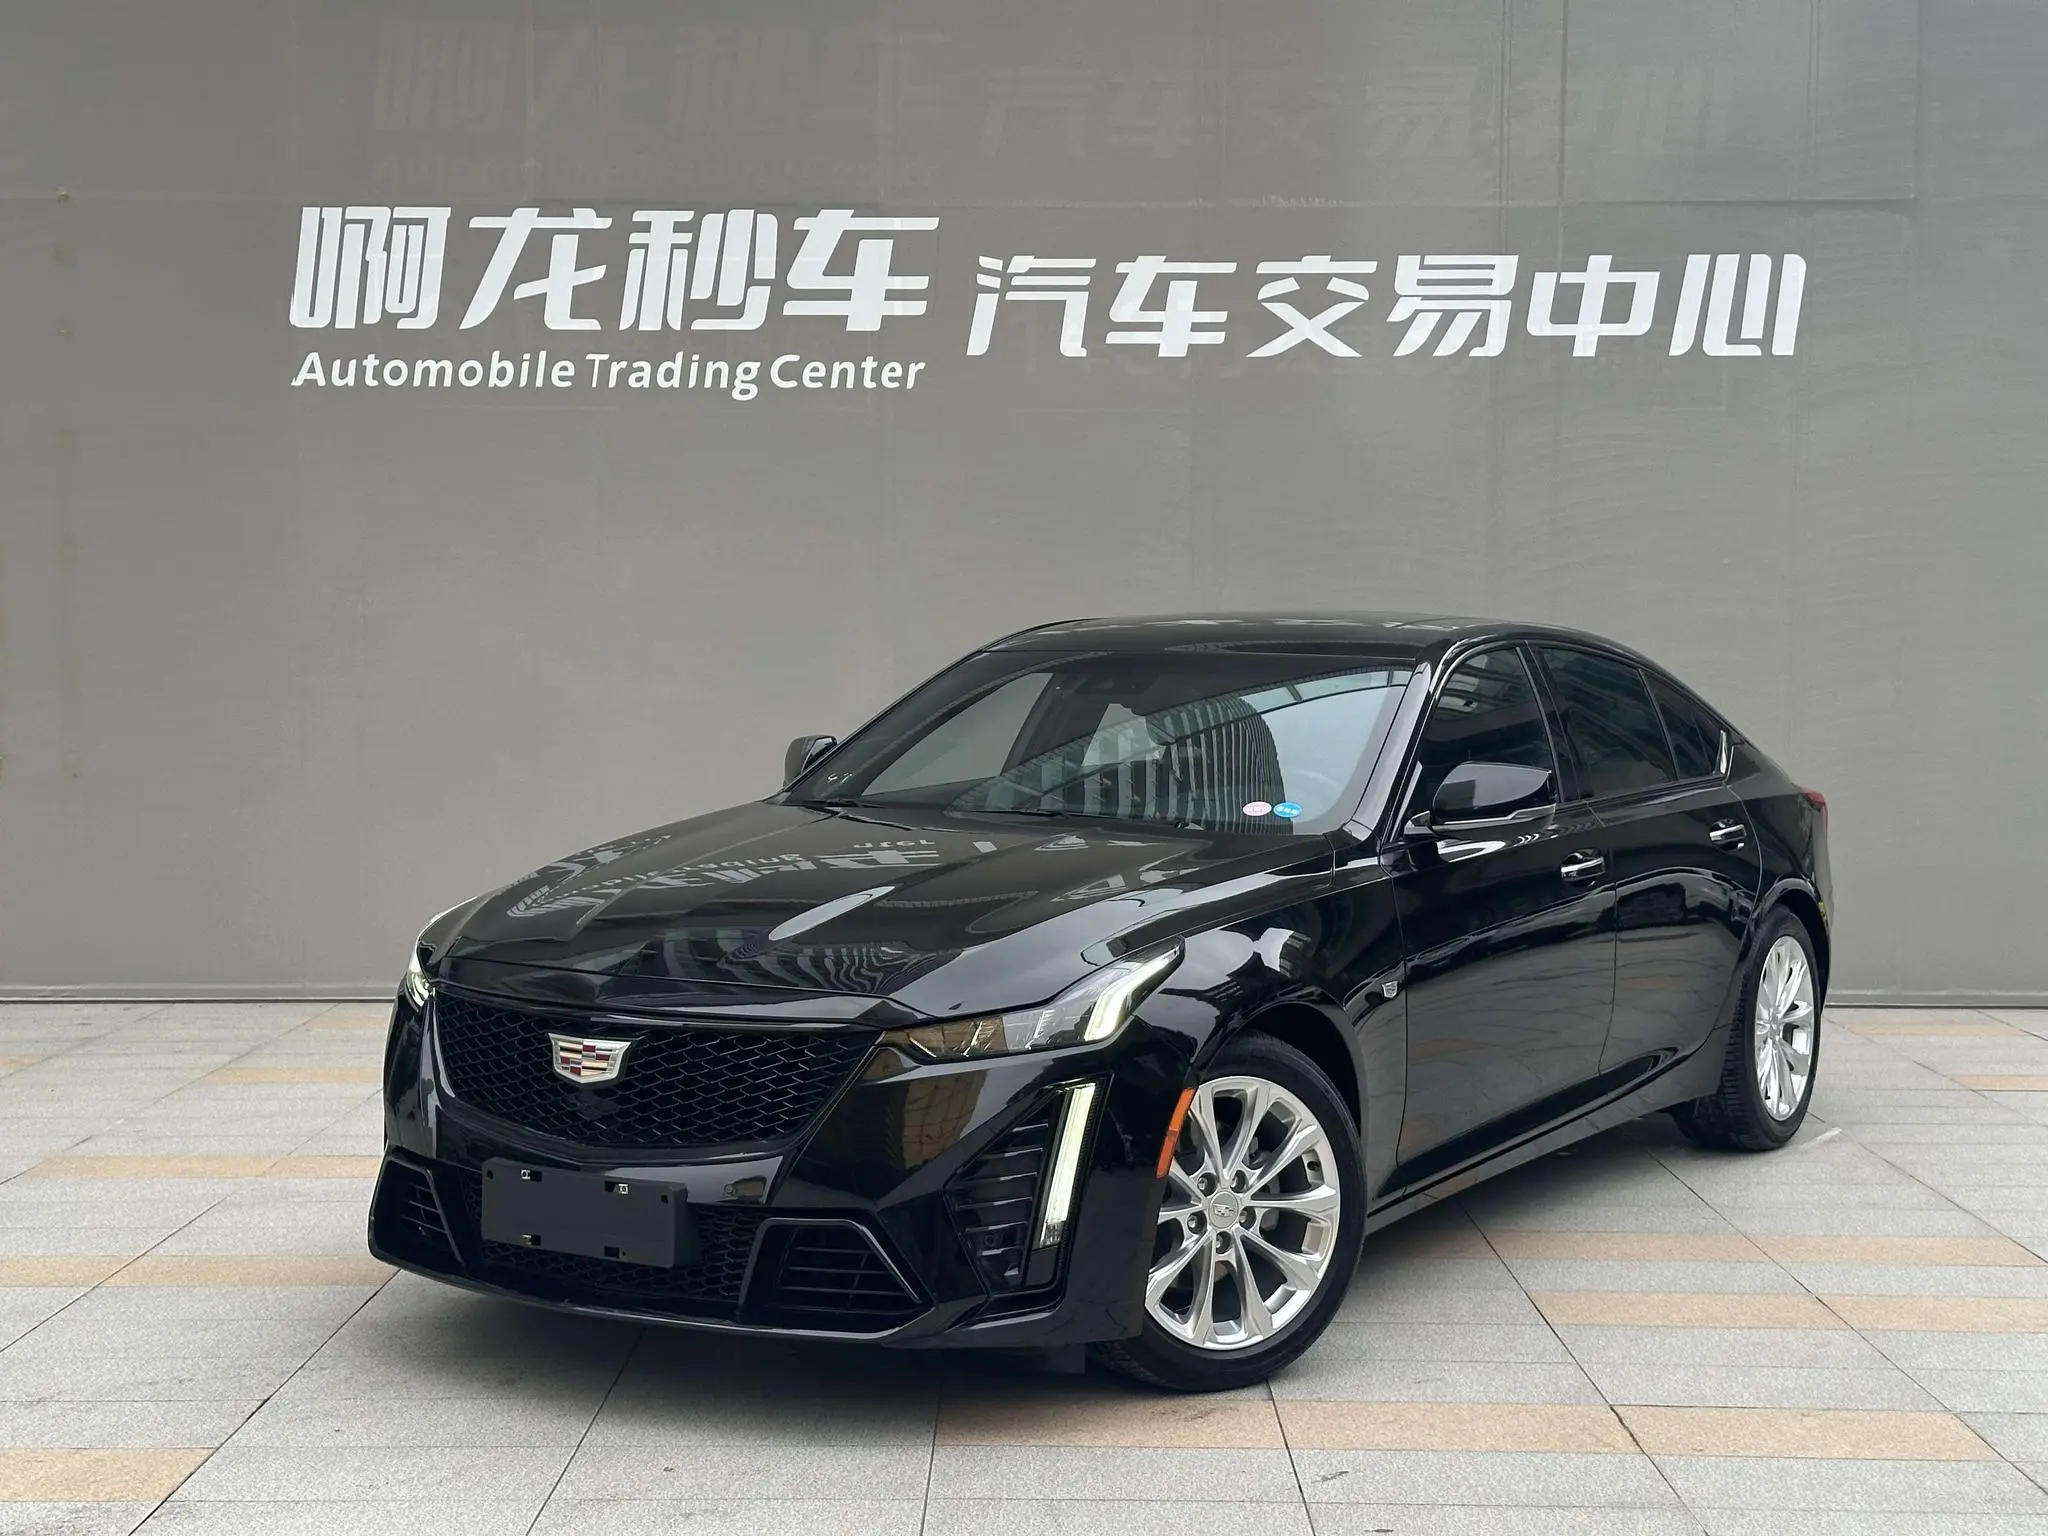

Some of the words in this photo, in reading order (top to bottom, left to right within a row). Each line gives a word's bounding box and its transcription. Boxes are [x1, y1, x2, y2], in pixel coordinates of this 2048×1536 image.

[289, 206, 940, 332] 啊龙秒车
[966, 252, 1807, 358] 汽车交易中心
[290, 350, 575, 389] Automobile
[585, 351, 761, 401] Trading
[770, 354, 926, 390] Center
